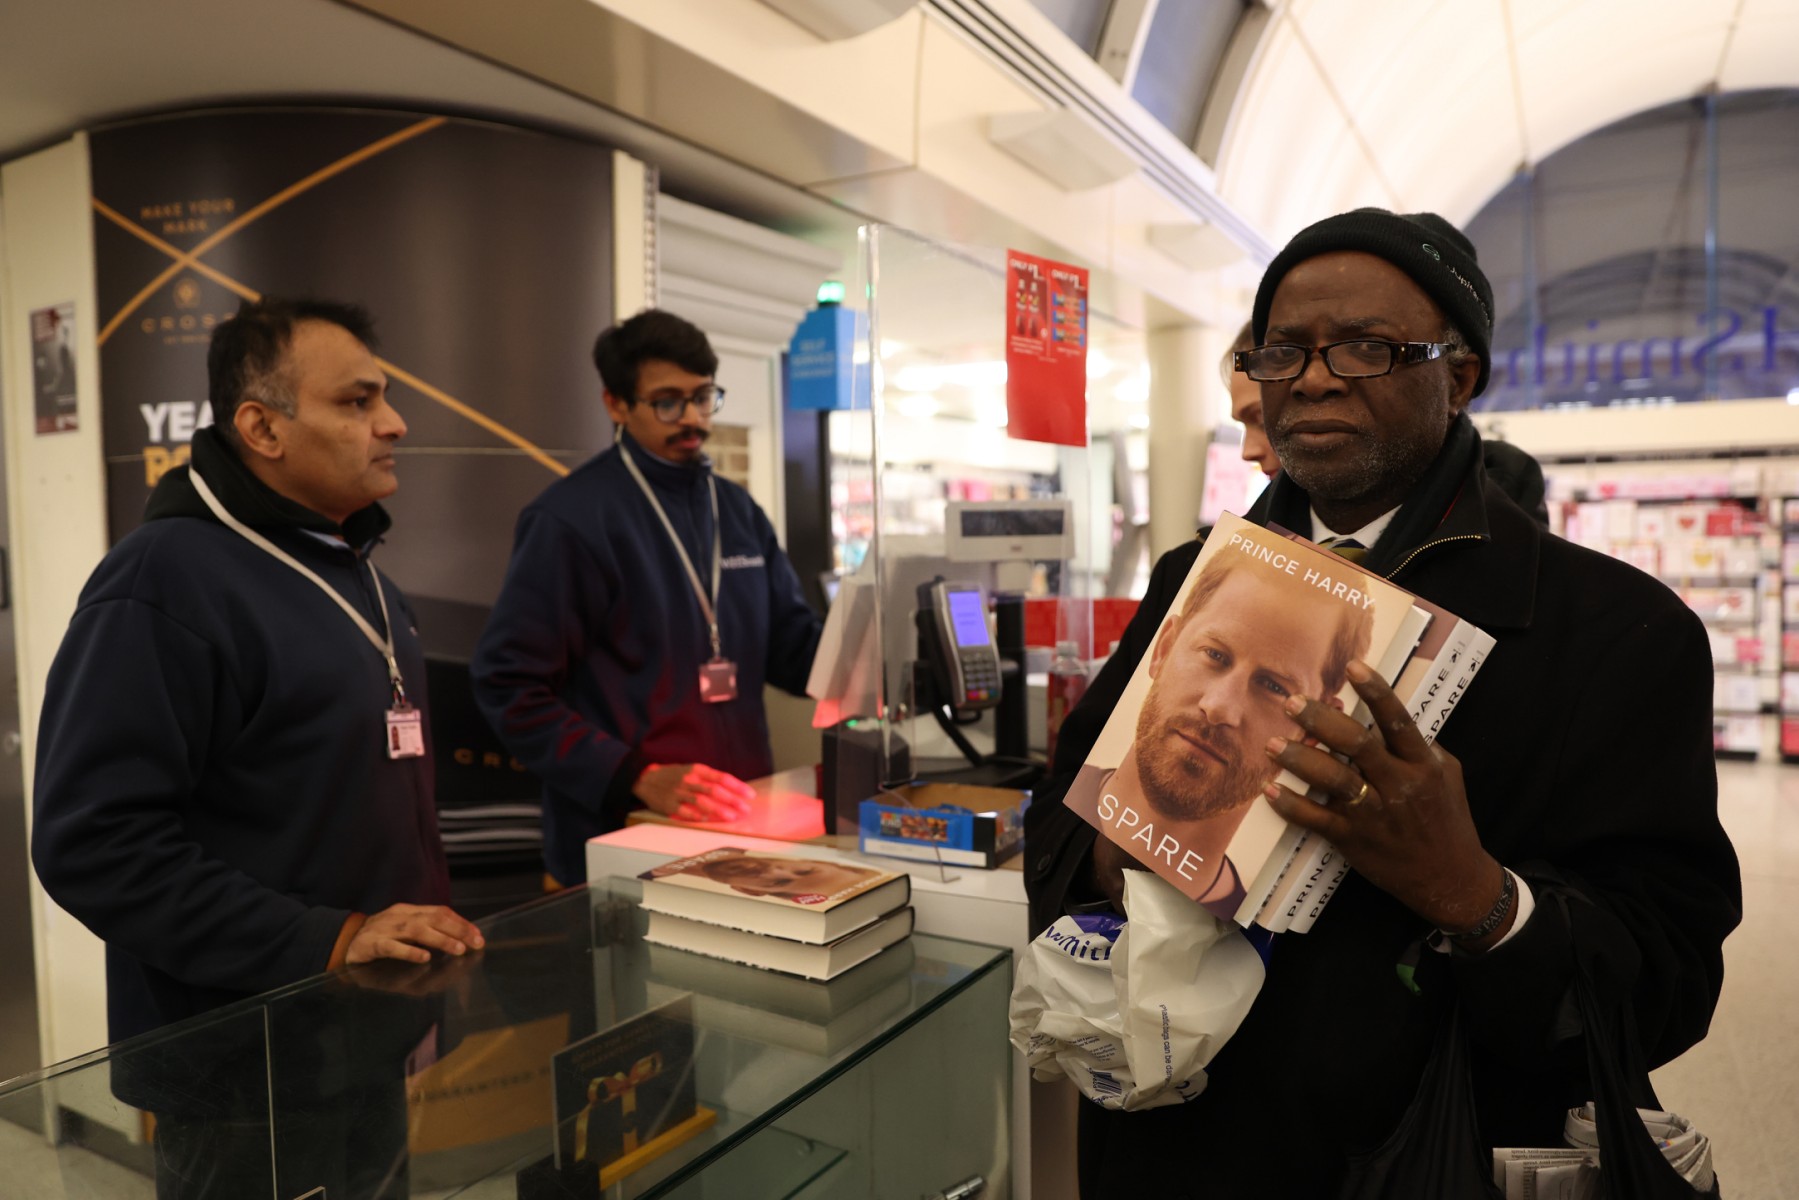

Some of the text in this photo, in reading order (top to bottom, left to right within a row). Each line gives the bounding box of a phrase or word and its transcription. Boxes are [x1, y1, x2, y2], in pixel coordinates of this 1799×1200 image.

[1228, 532, 1376, 612] PRINCE HARRY
[1412, 667, 1450, 725] PARE
[1424, 676, 1469, 747] SPARE
[1097, 793, 1204, 882] SPARE
[1163, 1041, 1171, 1054] can
[1165, 1055, 1172, 1064] be
